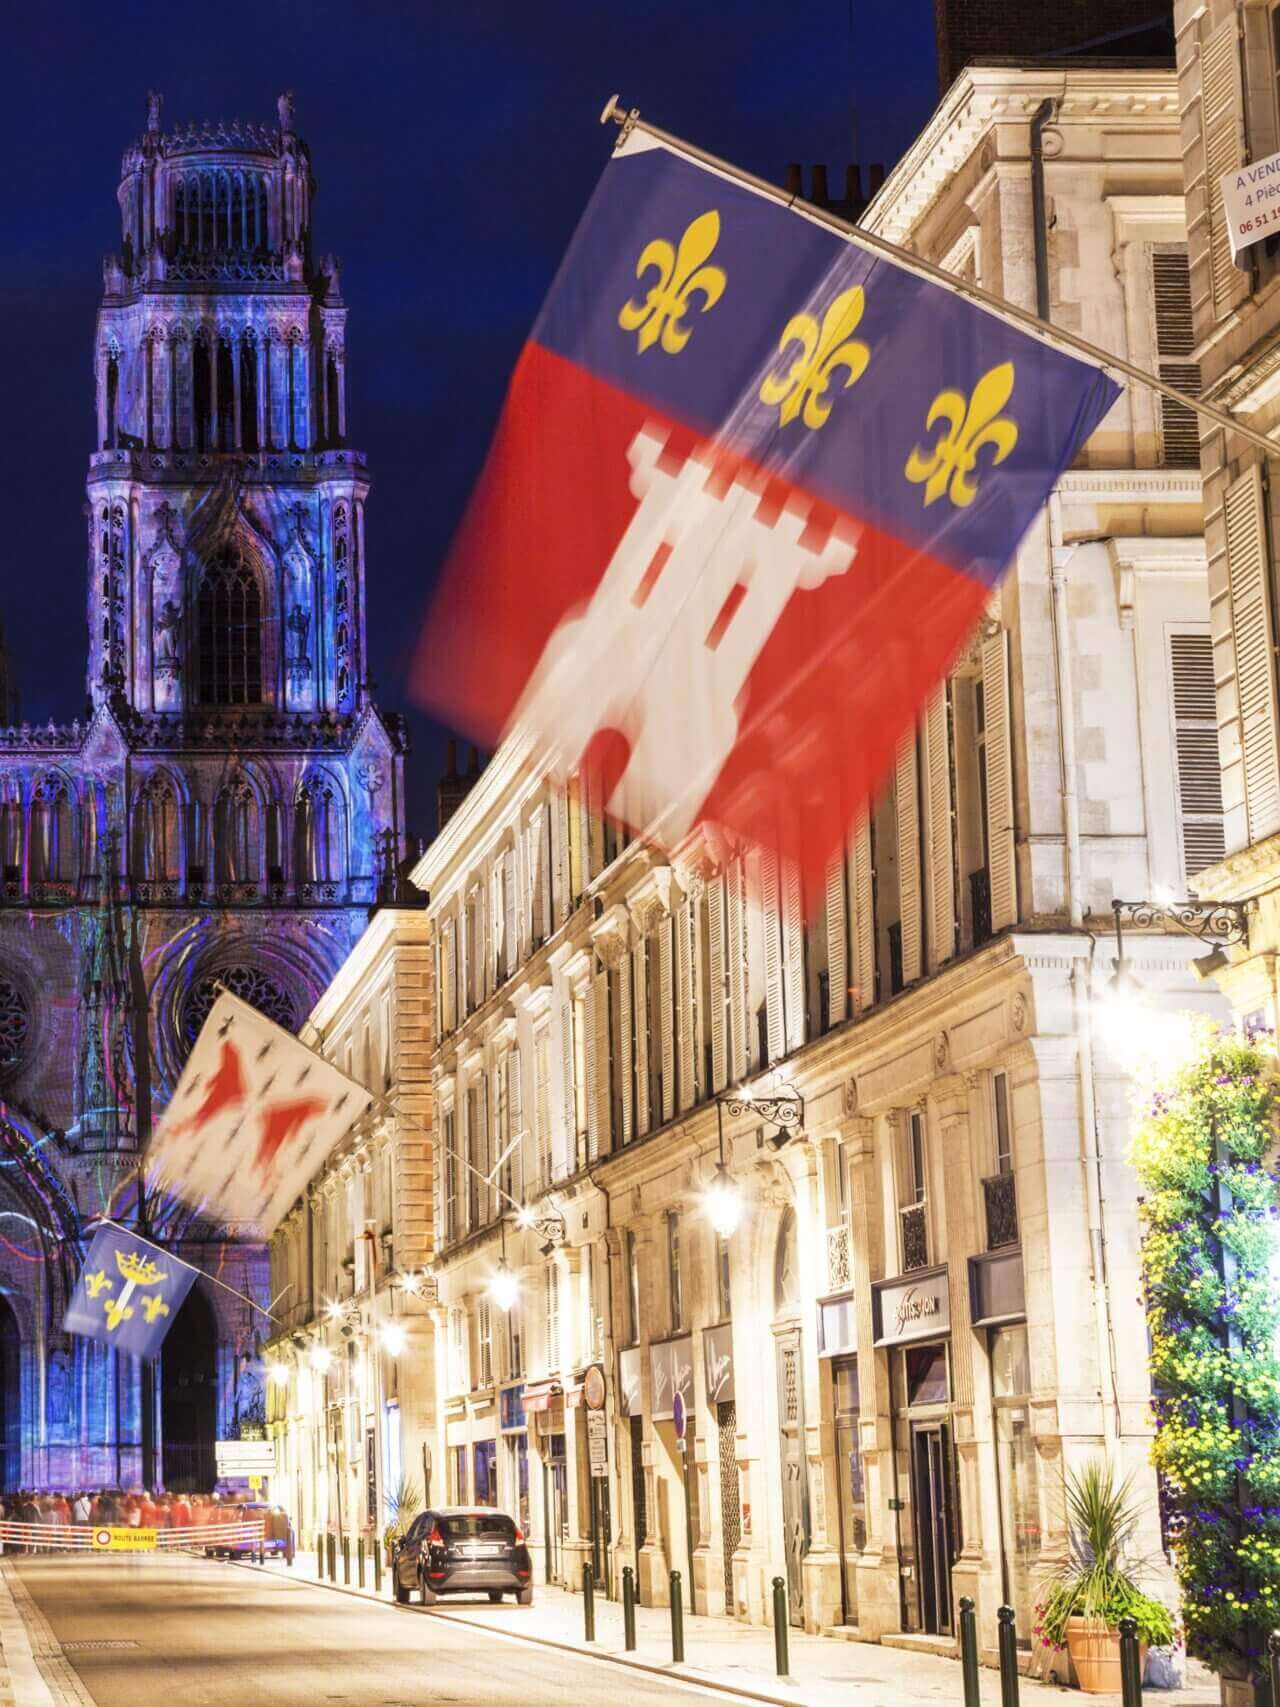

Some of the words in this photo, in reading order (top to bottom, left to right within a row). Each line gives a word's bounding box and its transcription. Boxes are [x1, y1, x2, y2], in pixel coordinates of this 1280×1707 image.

[1236, 176, 1247, 191] A
[1245, 194, 1253, 207] 4
[1239, 220, 1253, 234] 06
[1255, 213, 1269, 228] 51
